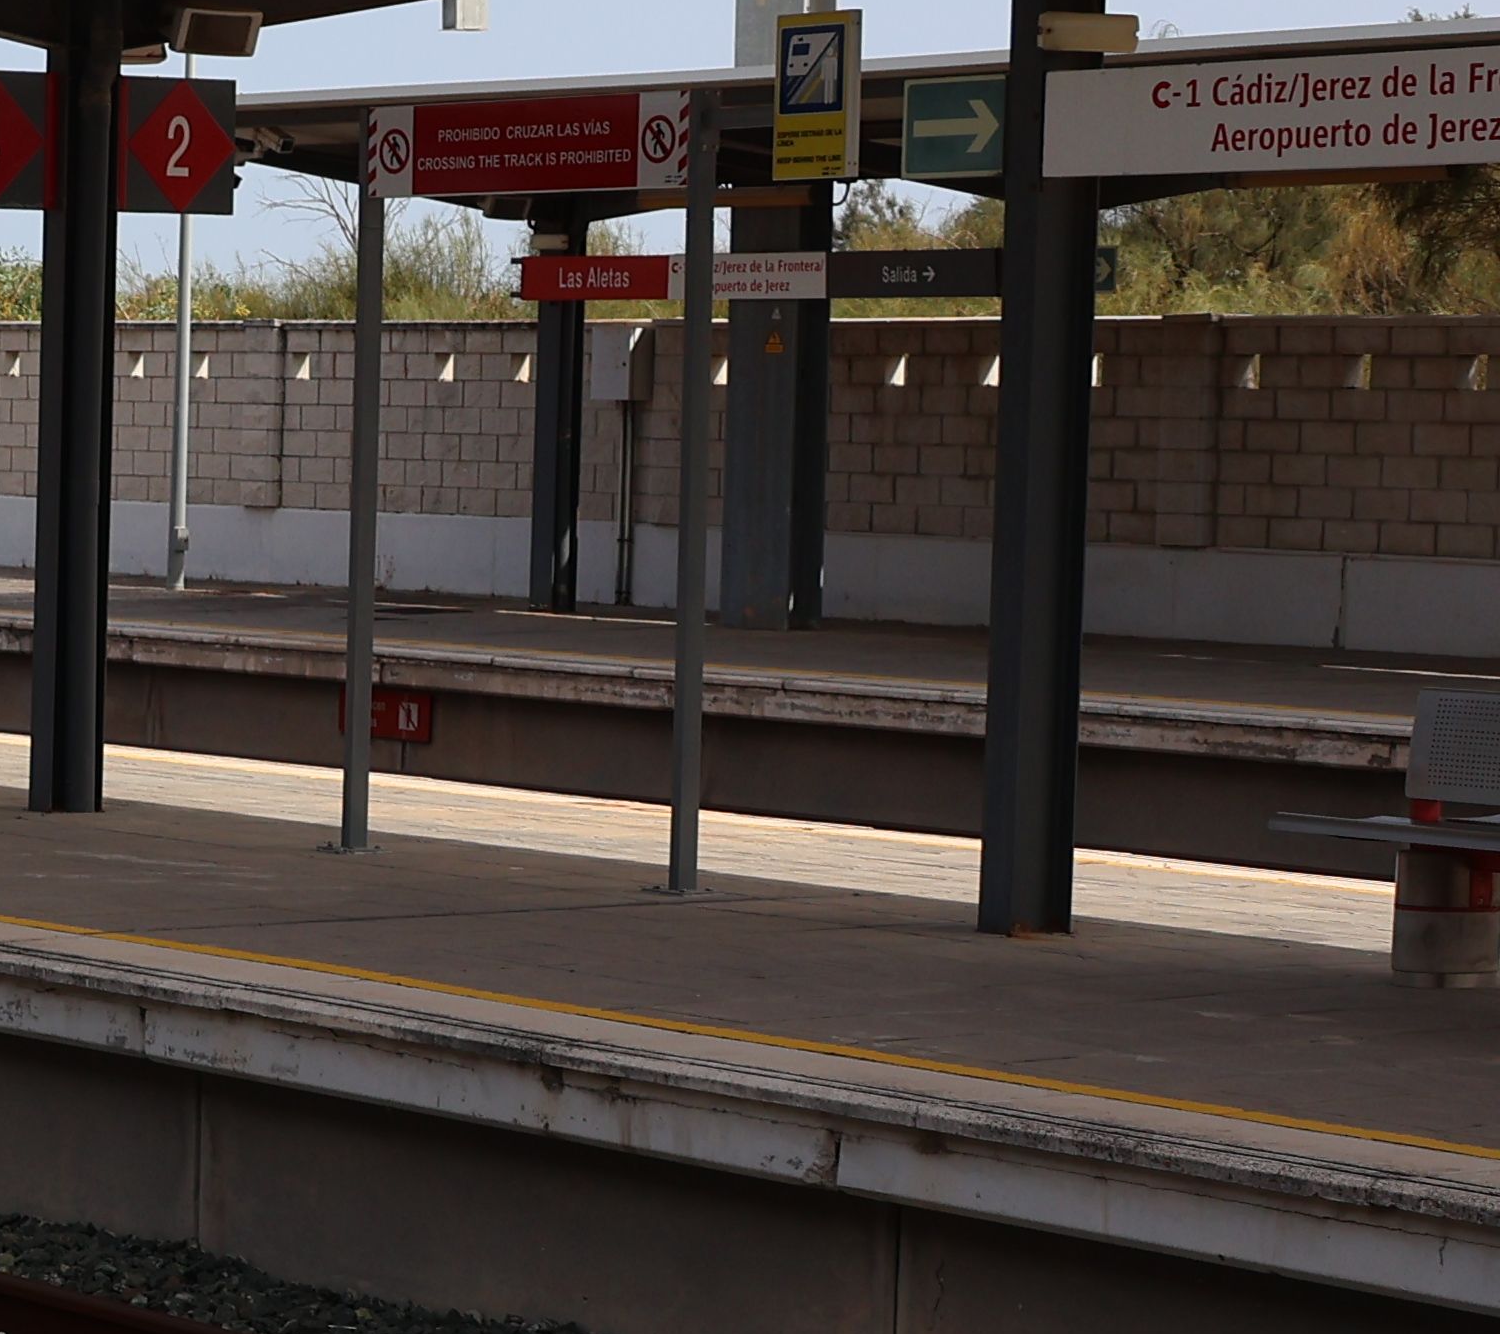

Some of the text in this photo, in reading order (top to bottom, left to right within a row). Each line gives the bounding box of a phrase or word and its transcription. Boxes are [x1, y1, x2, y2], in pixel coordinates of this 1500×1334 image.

[1151, 79, 1201, 109] C-1
[1212, 72, 1371, 108] Cádiz/Jerez
[1382, 65, 1417, 97] de
[1428, 63, 1455, 96] la
[438, 118, 610, 142] PROHIBIDO CRUZAR LAS VÍAS
[1211, 113, 1500, 158] Aeropuerto de Jerez
[166, 115, 191, 177] 2
[417, 149, 631, 171] CROSSING THE TRACK IS PROHIBITED
[559, 266, 630, 289] Las Aletas
[750, 260, 761, 273] de
[765, 260, 774, 272] la
[882, 265, 917, 283] Salida
[750, 279, 762, 292] de
[765, 279, 790, 294] Jerez
